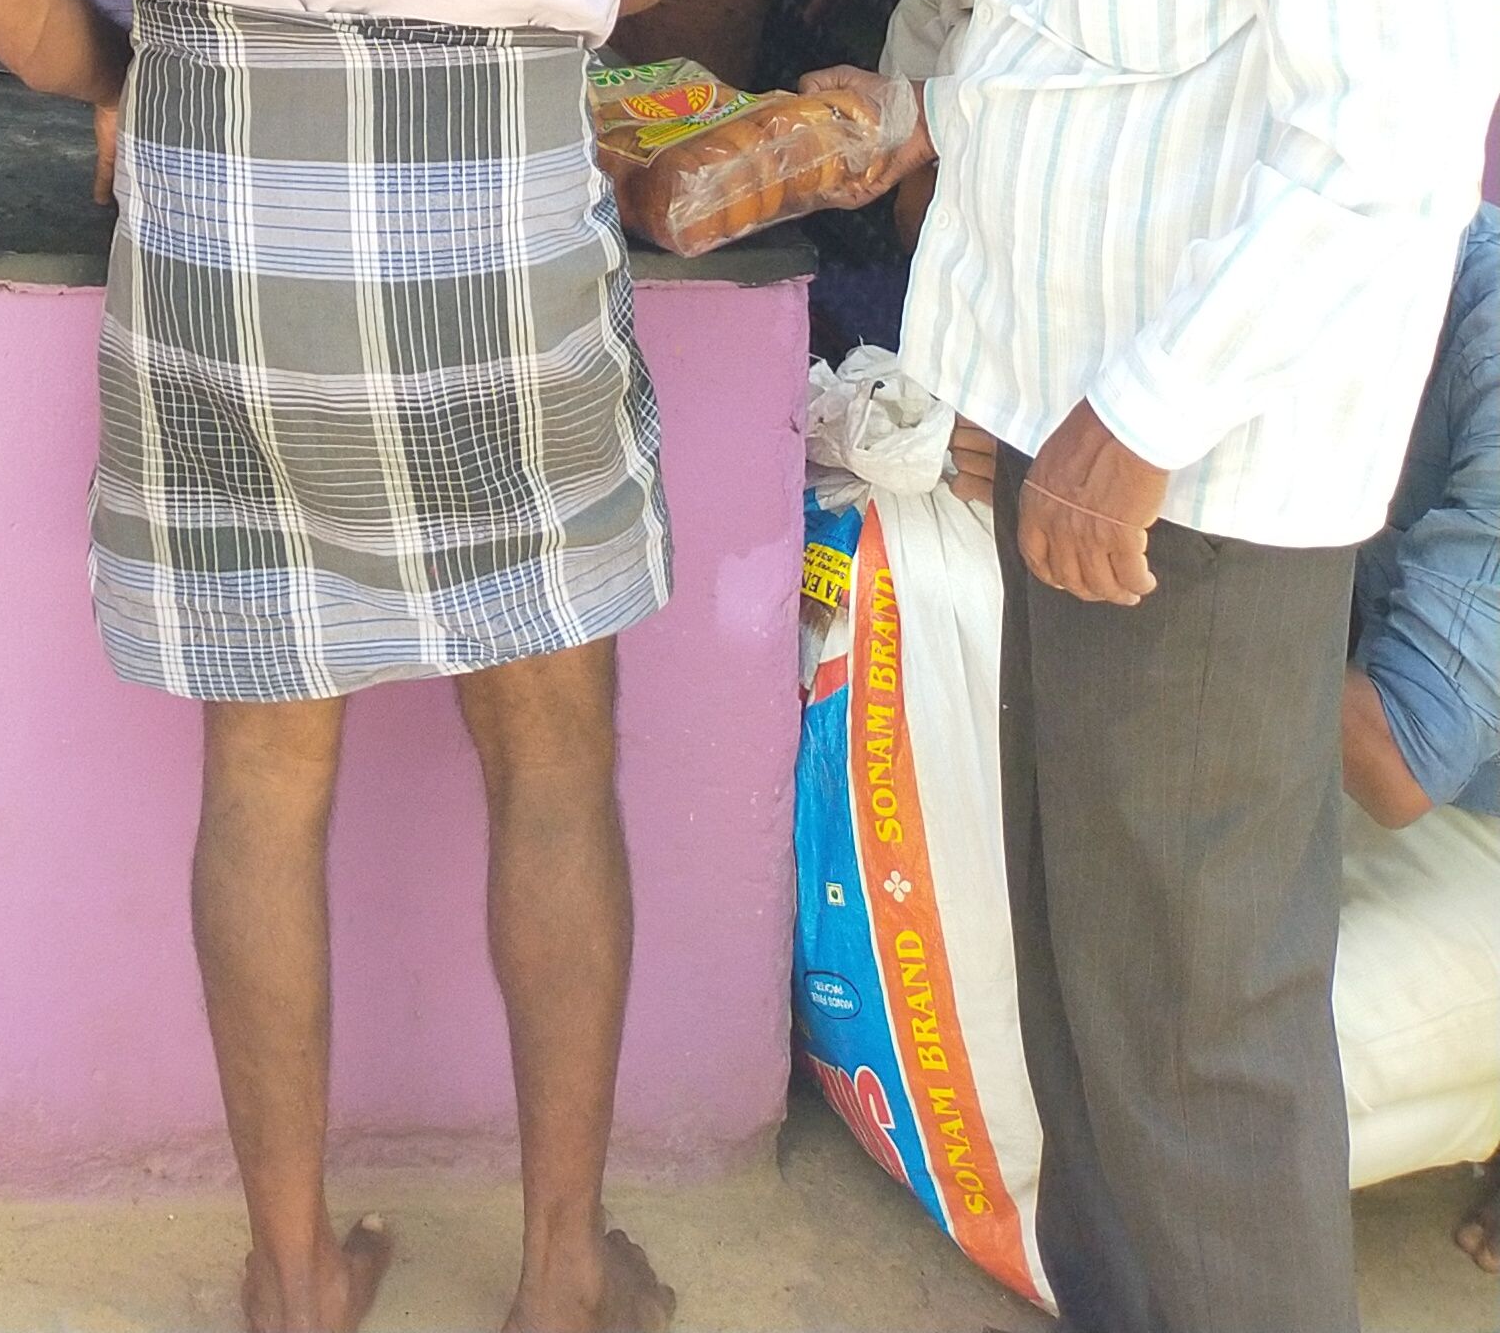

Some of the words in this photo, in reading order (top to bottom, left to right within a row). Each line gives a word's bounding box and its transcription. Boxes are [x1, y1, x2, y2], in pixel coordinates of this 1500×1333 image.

[868, 566, 899, 694] BRAND
[866, 702, 904, 843] SONAM
[894, 929, 950, 1073] BRAND
[927, 1086, 994, 1216] SONAM
